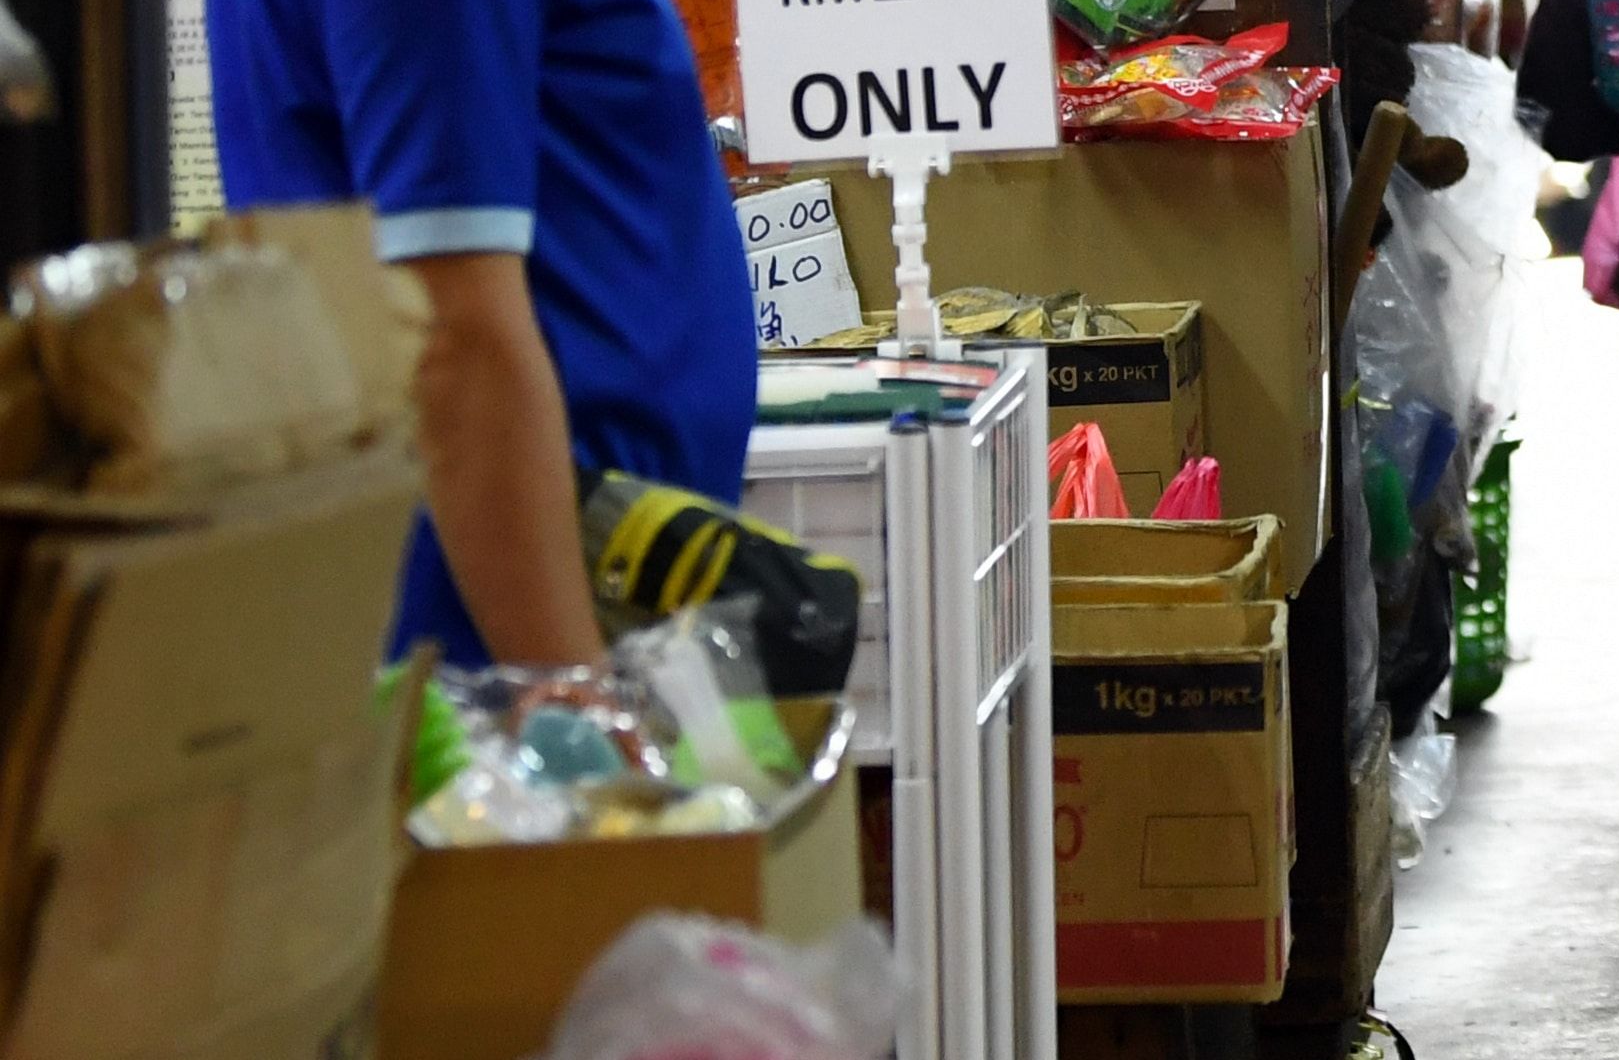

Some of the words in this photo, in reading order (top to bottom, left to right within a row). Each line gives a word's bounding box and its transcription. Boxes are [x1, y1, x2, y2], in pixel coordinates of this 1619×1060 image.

[790, 61, 1007, 141] ONLY
[1098, 366, 1119, 382] 20
[1123, 364, 1159, 381] PKT
[1094, 680, 1157, 718] 1kg
[1179, 689, 1202, 707] 20
